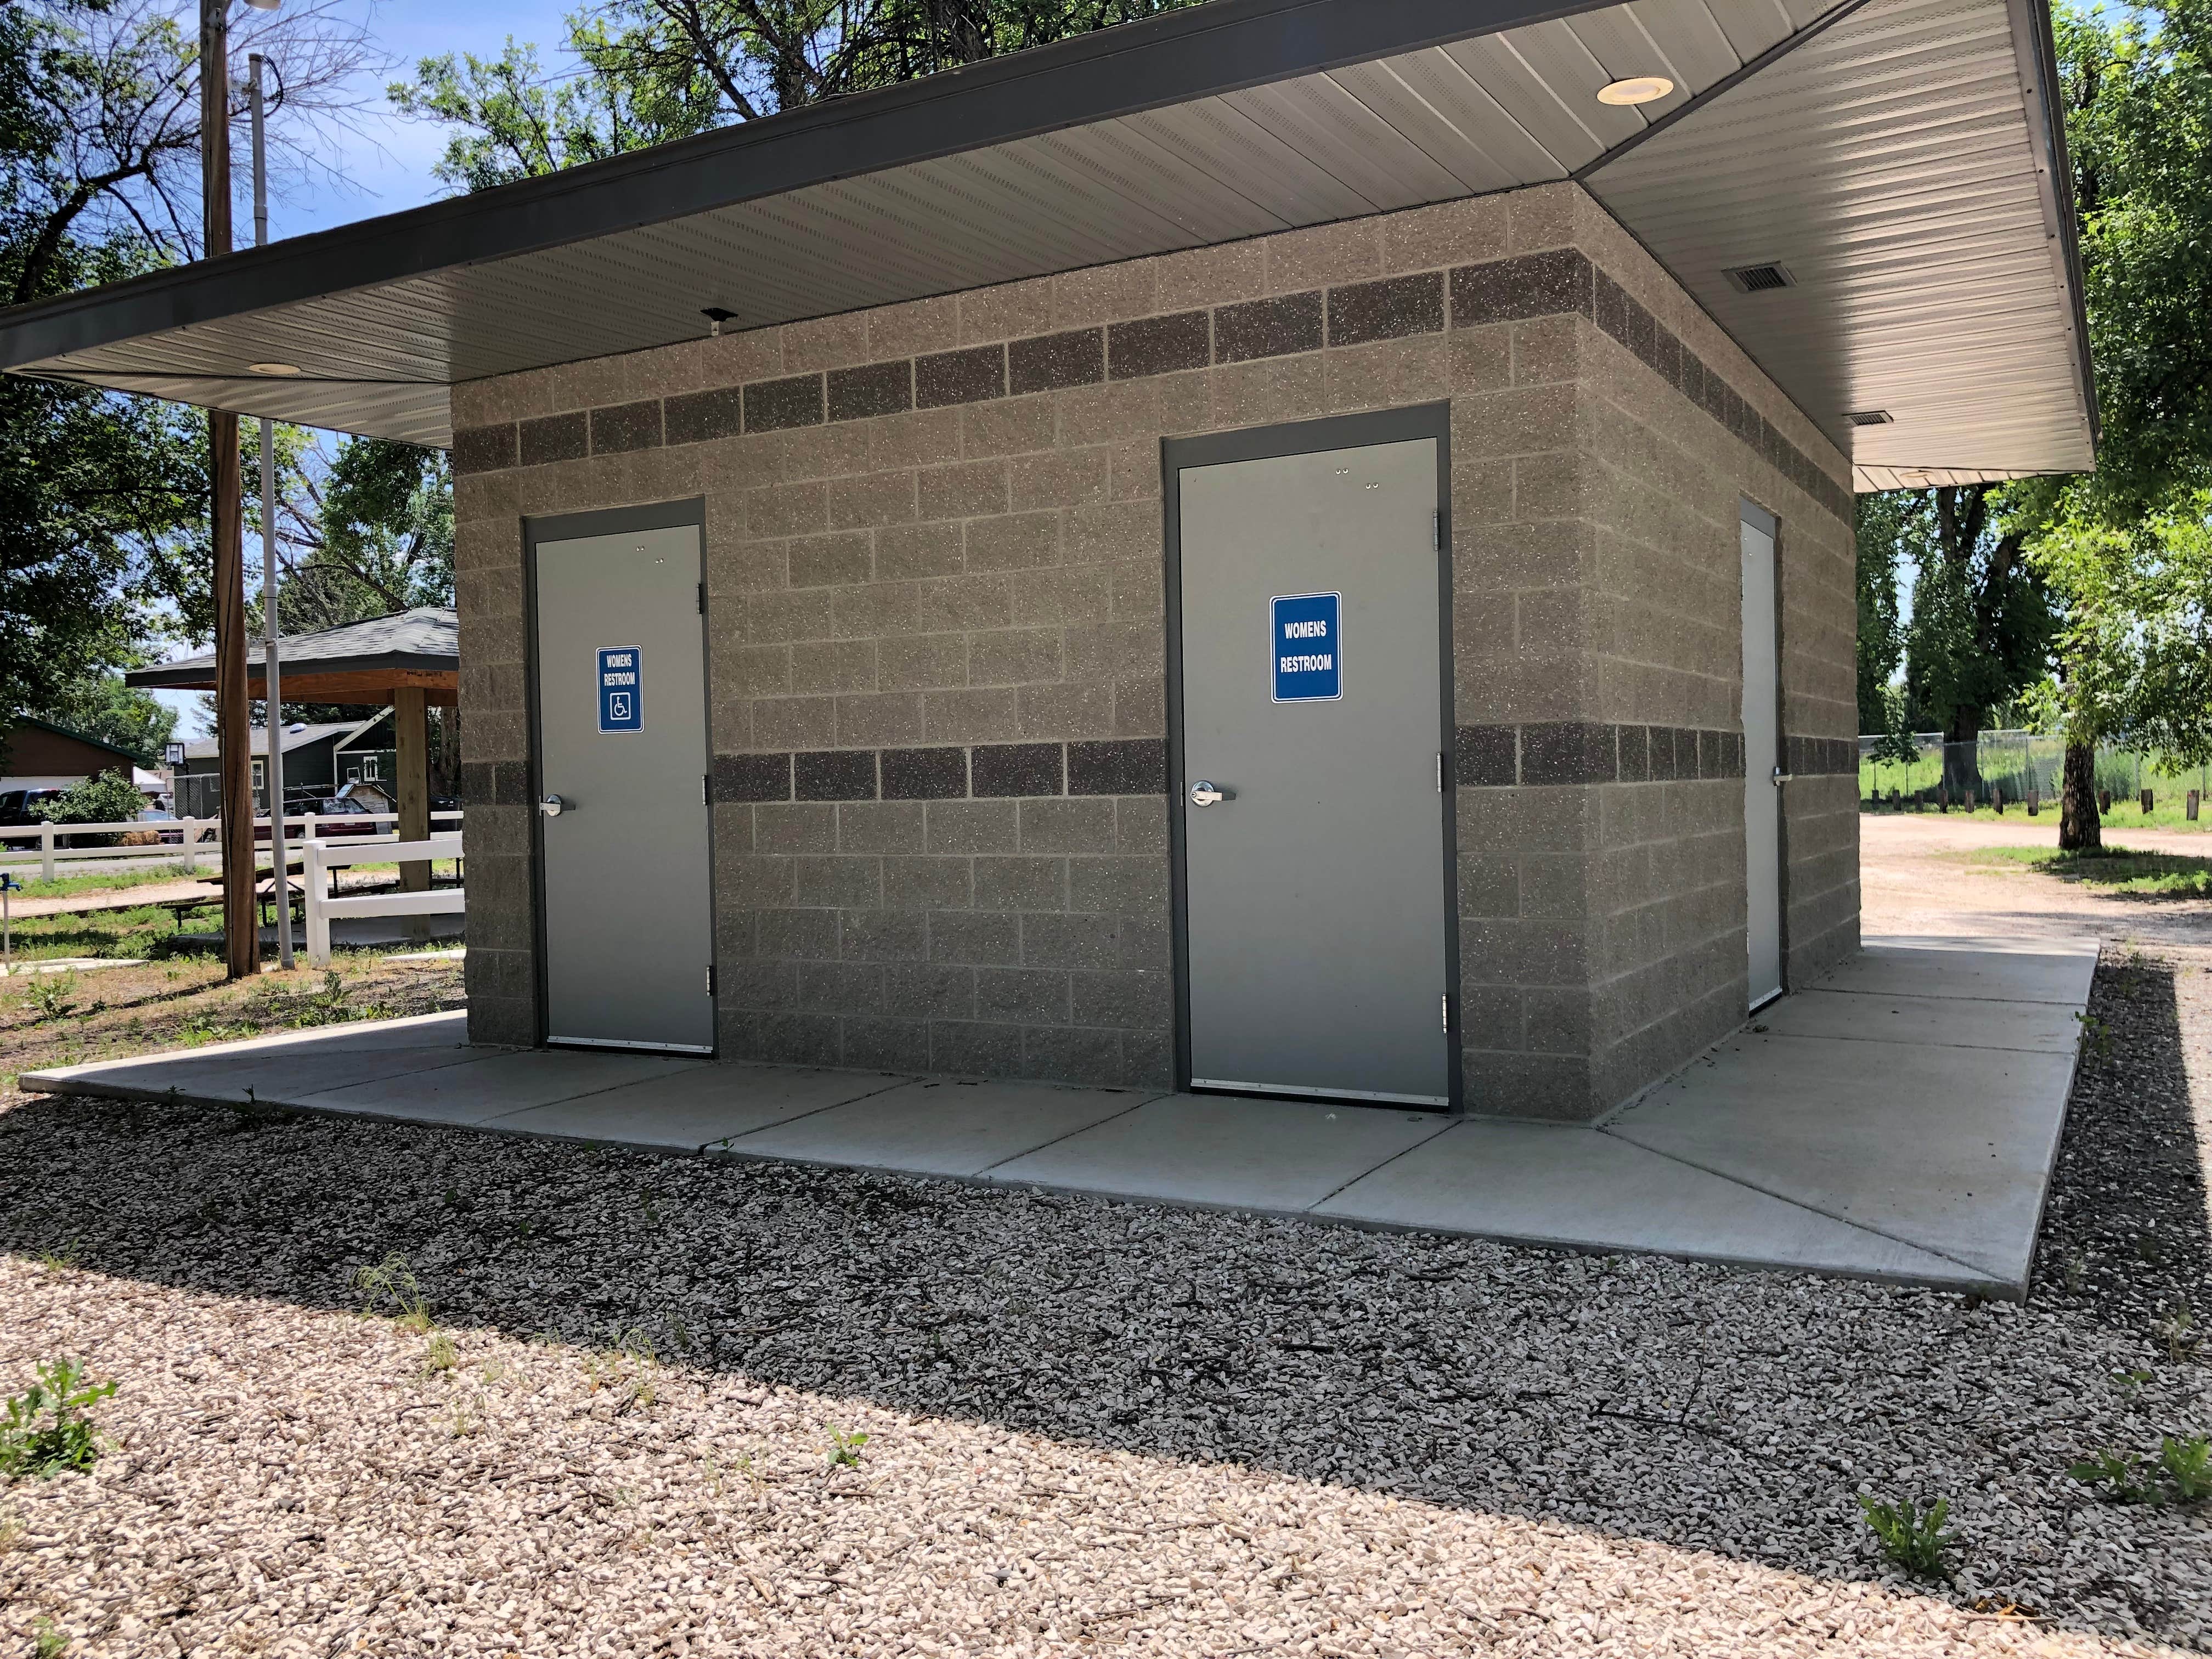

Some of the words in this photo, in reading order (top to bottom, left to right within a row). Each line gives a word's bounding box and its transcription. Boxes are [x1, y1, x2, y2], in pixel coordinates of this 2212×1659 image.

[1284, 620, 1327, 639] WOMENS
[606, 653, 632, 668] WOMENS
[1280, 654, 1332, 673] RESTROOM
[604, 672, 635, 686] RESTROOM
